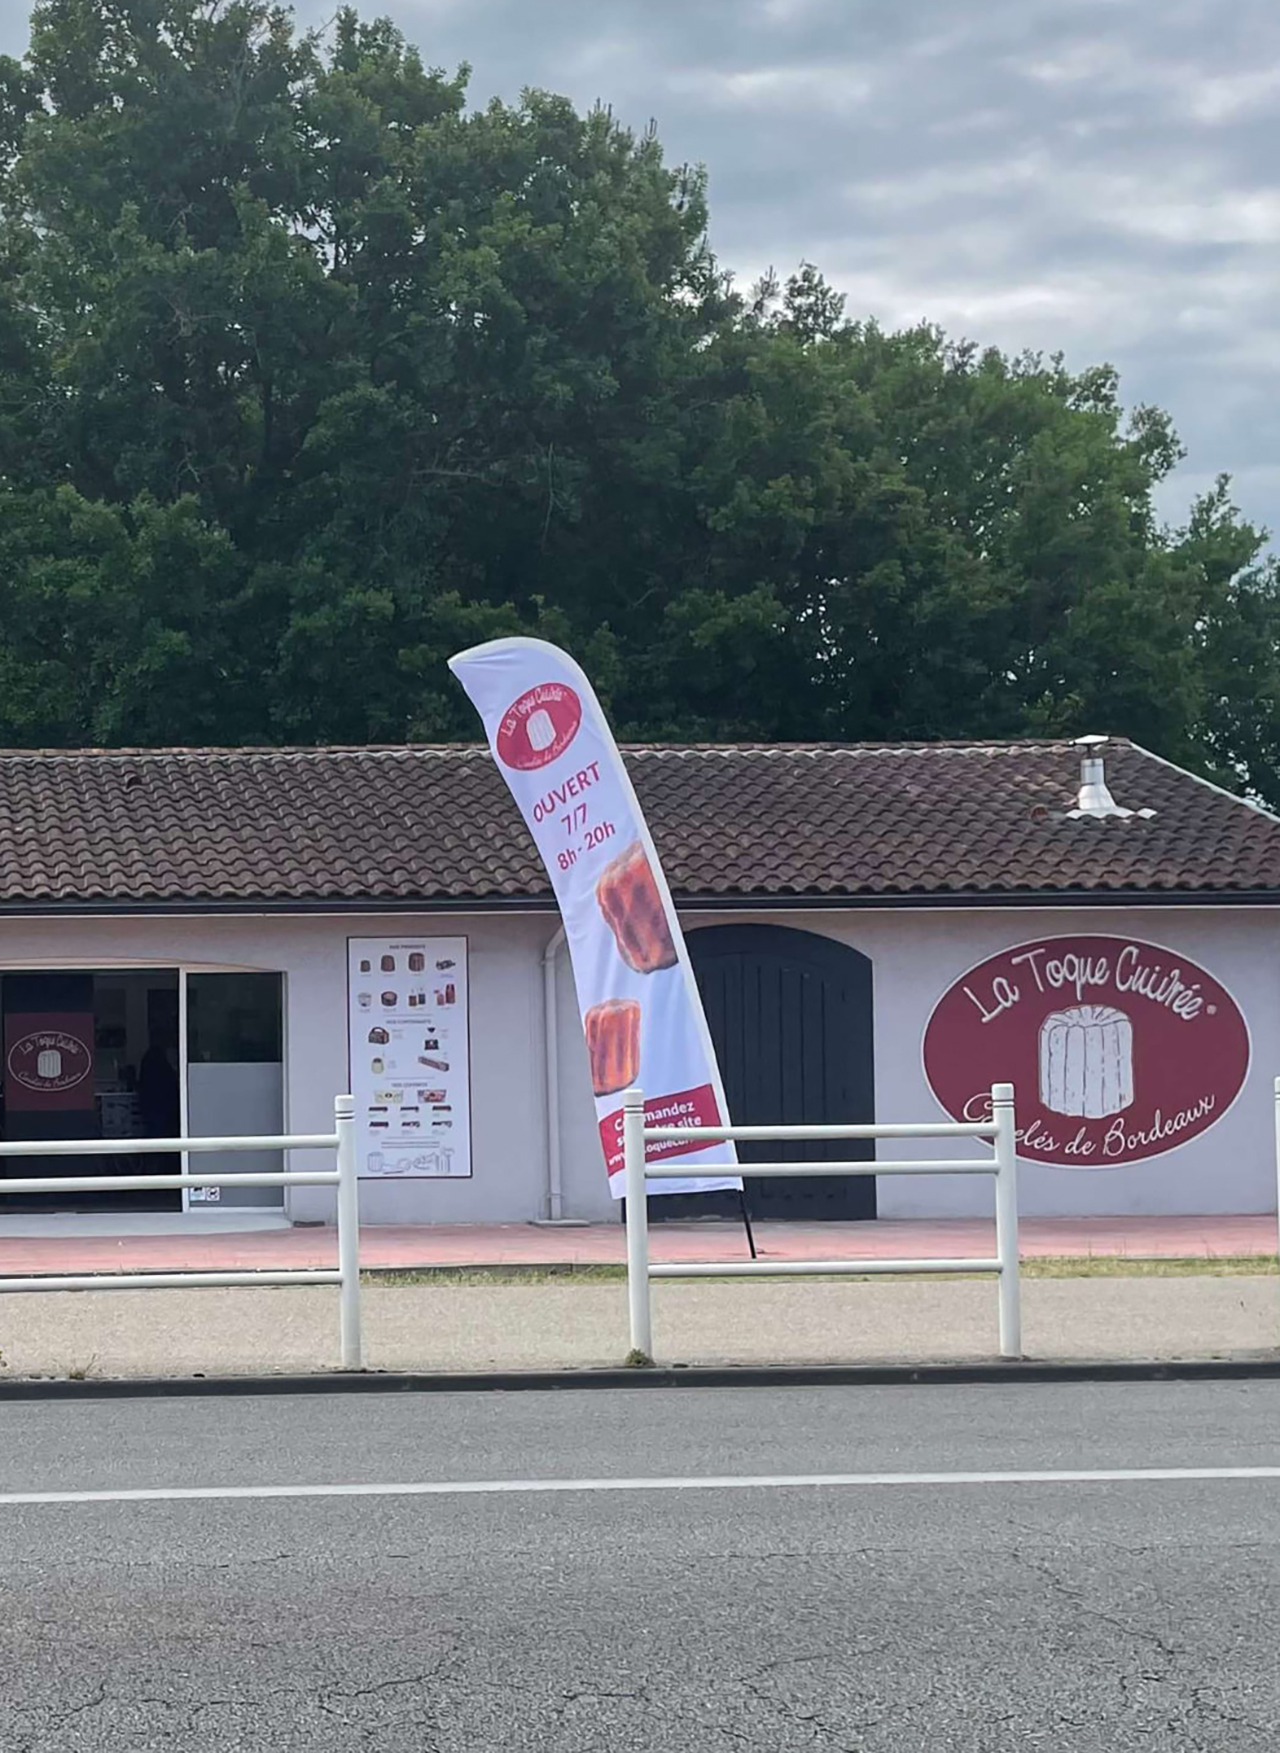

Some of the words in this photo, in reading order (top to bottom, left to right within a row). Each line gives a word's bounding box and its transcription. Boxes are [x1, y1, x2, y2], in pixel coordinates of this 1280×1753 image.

[533, 761, 600, 823] OUVERT
[561, 802, 587, 836] 7/7
[557, 848, 577, 870] 8h
[584, 821, 616, 851] 20h
[964, 976, 1019, 1023] La
[1012, 948, 1111, 1001] Toque
[963, 1093, 1060, 1151] Celés
[1064, 1127, 1097, 1156] de
[1102, 1094, 1216, 1157] Bordeaux
